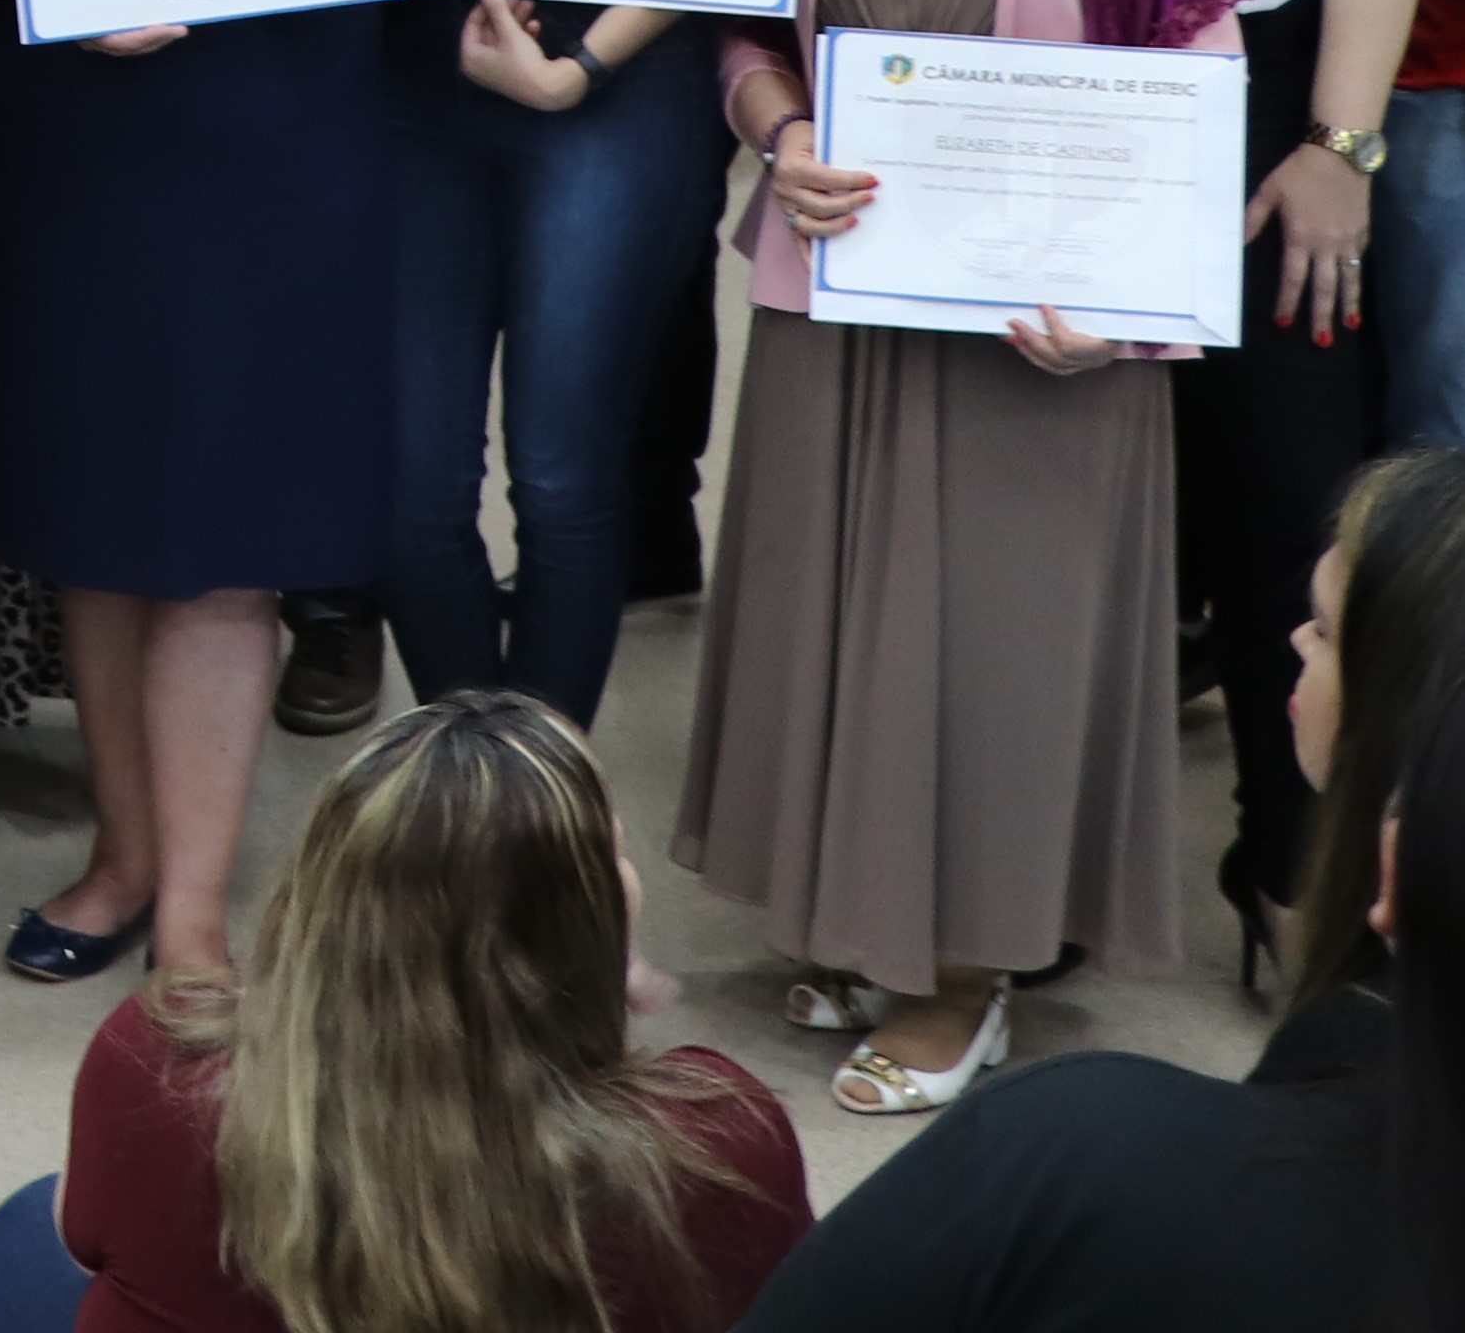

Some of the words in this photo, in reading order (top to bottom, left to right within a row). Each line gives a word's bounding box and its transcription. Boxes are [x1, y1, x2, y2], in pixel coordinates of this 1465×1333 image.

[921, 63, 1001, 84] CÂMARA
[1007, 72, 1108, 91] MUNICIPAL
[1114, 79, 1135, 93] DE
[1018, 141, 1040, 155] DE
